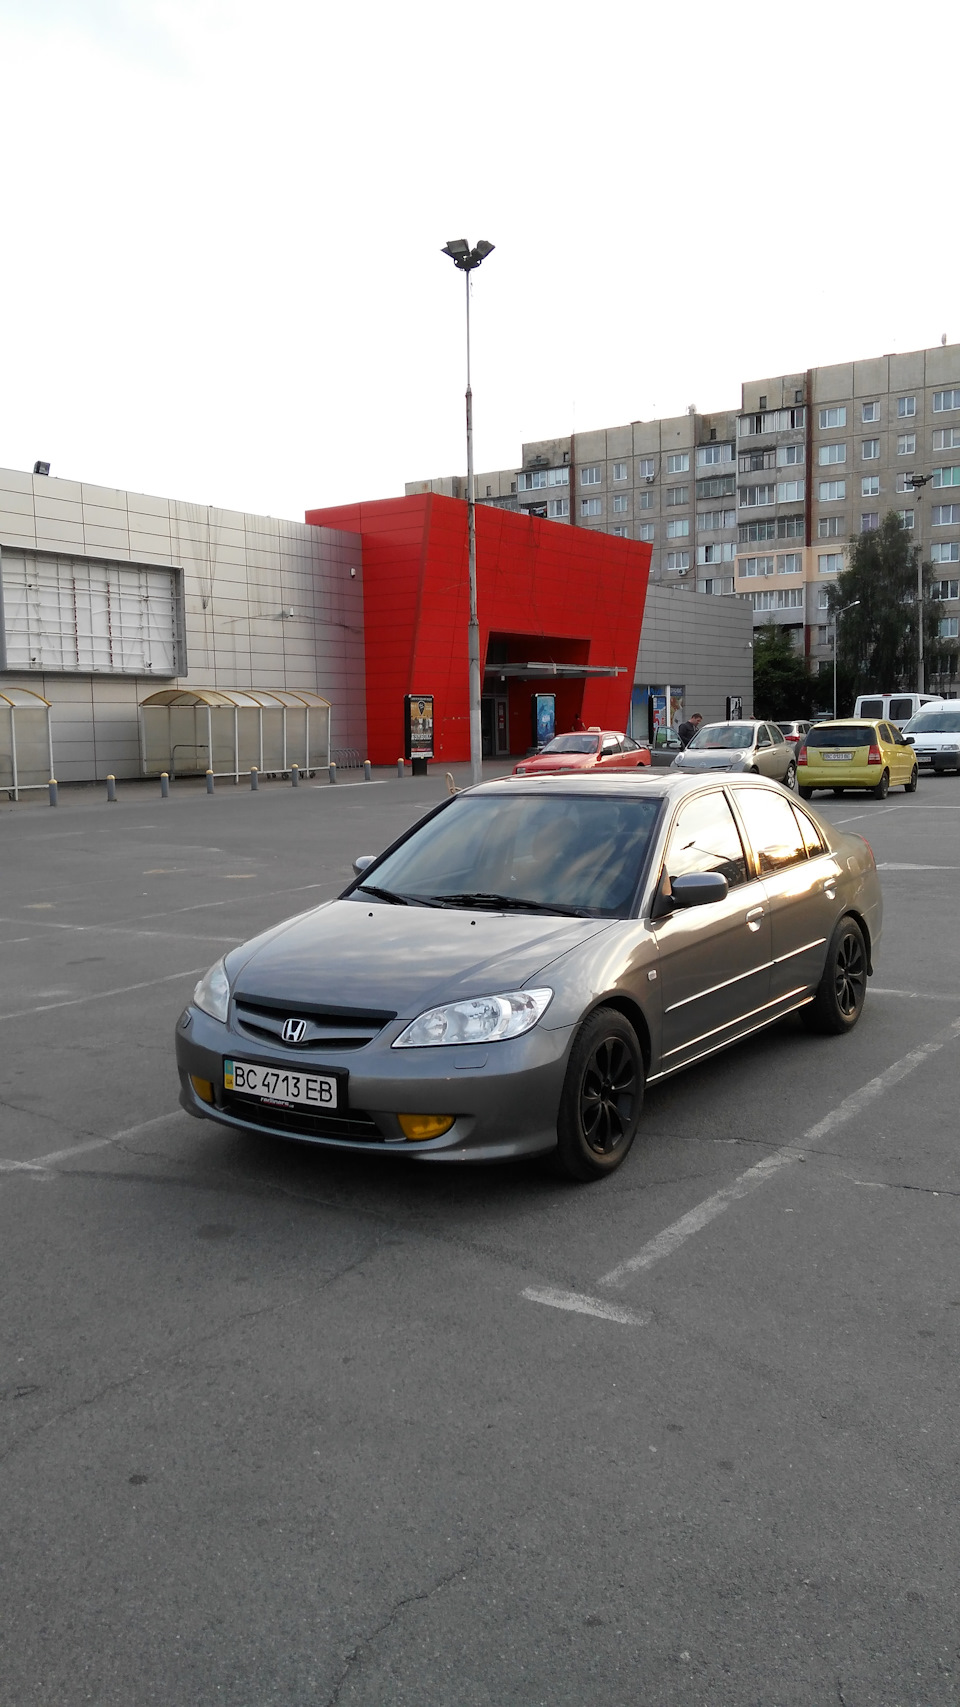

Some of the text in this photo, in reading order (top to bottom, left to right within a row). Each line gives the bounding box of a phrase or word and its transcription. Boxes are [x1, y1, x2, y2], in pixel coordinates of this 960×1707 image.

[234, 1066, 333, 1103] BC 4713 EB
